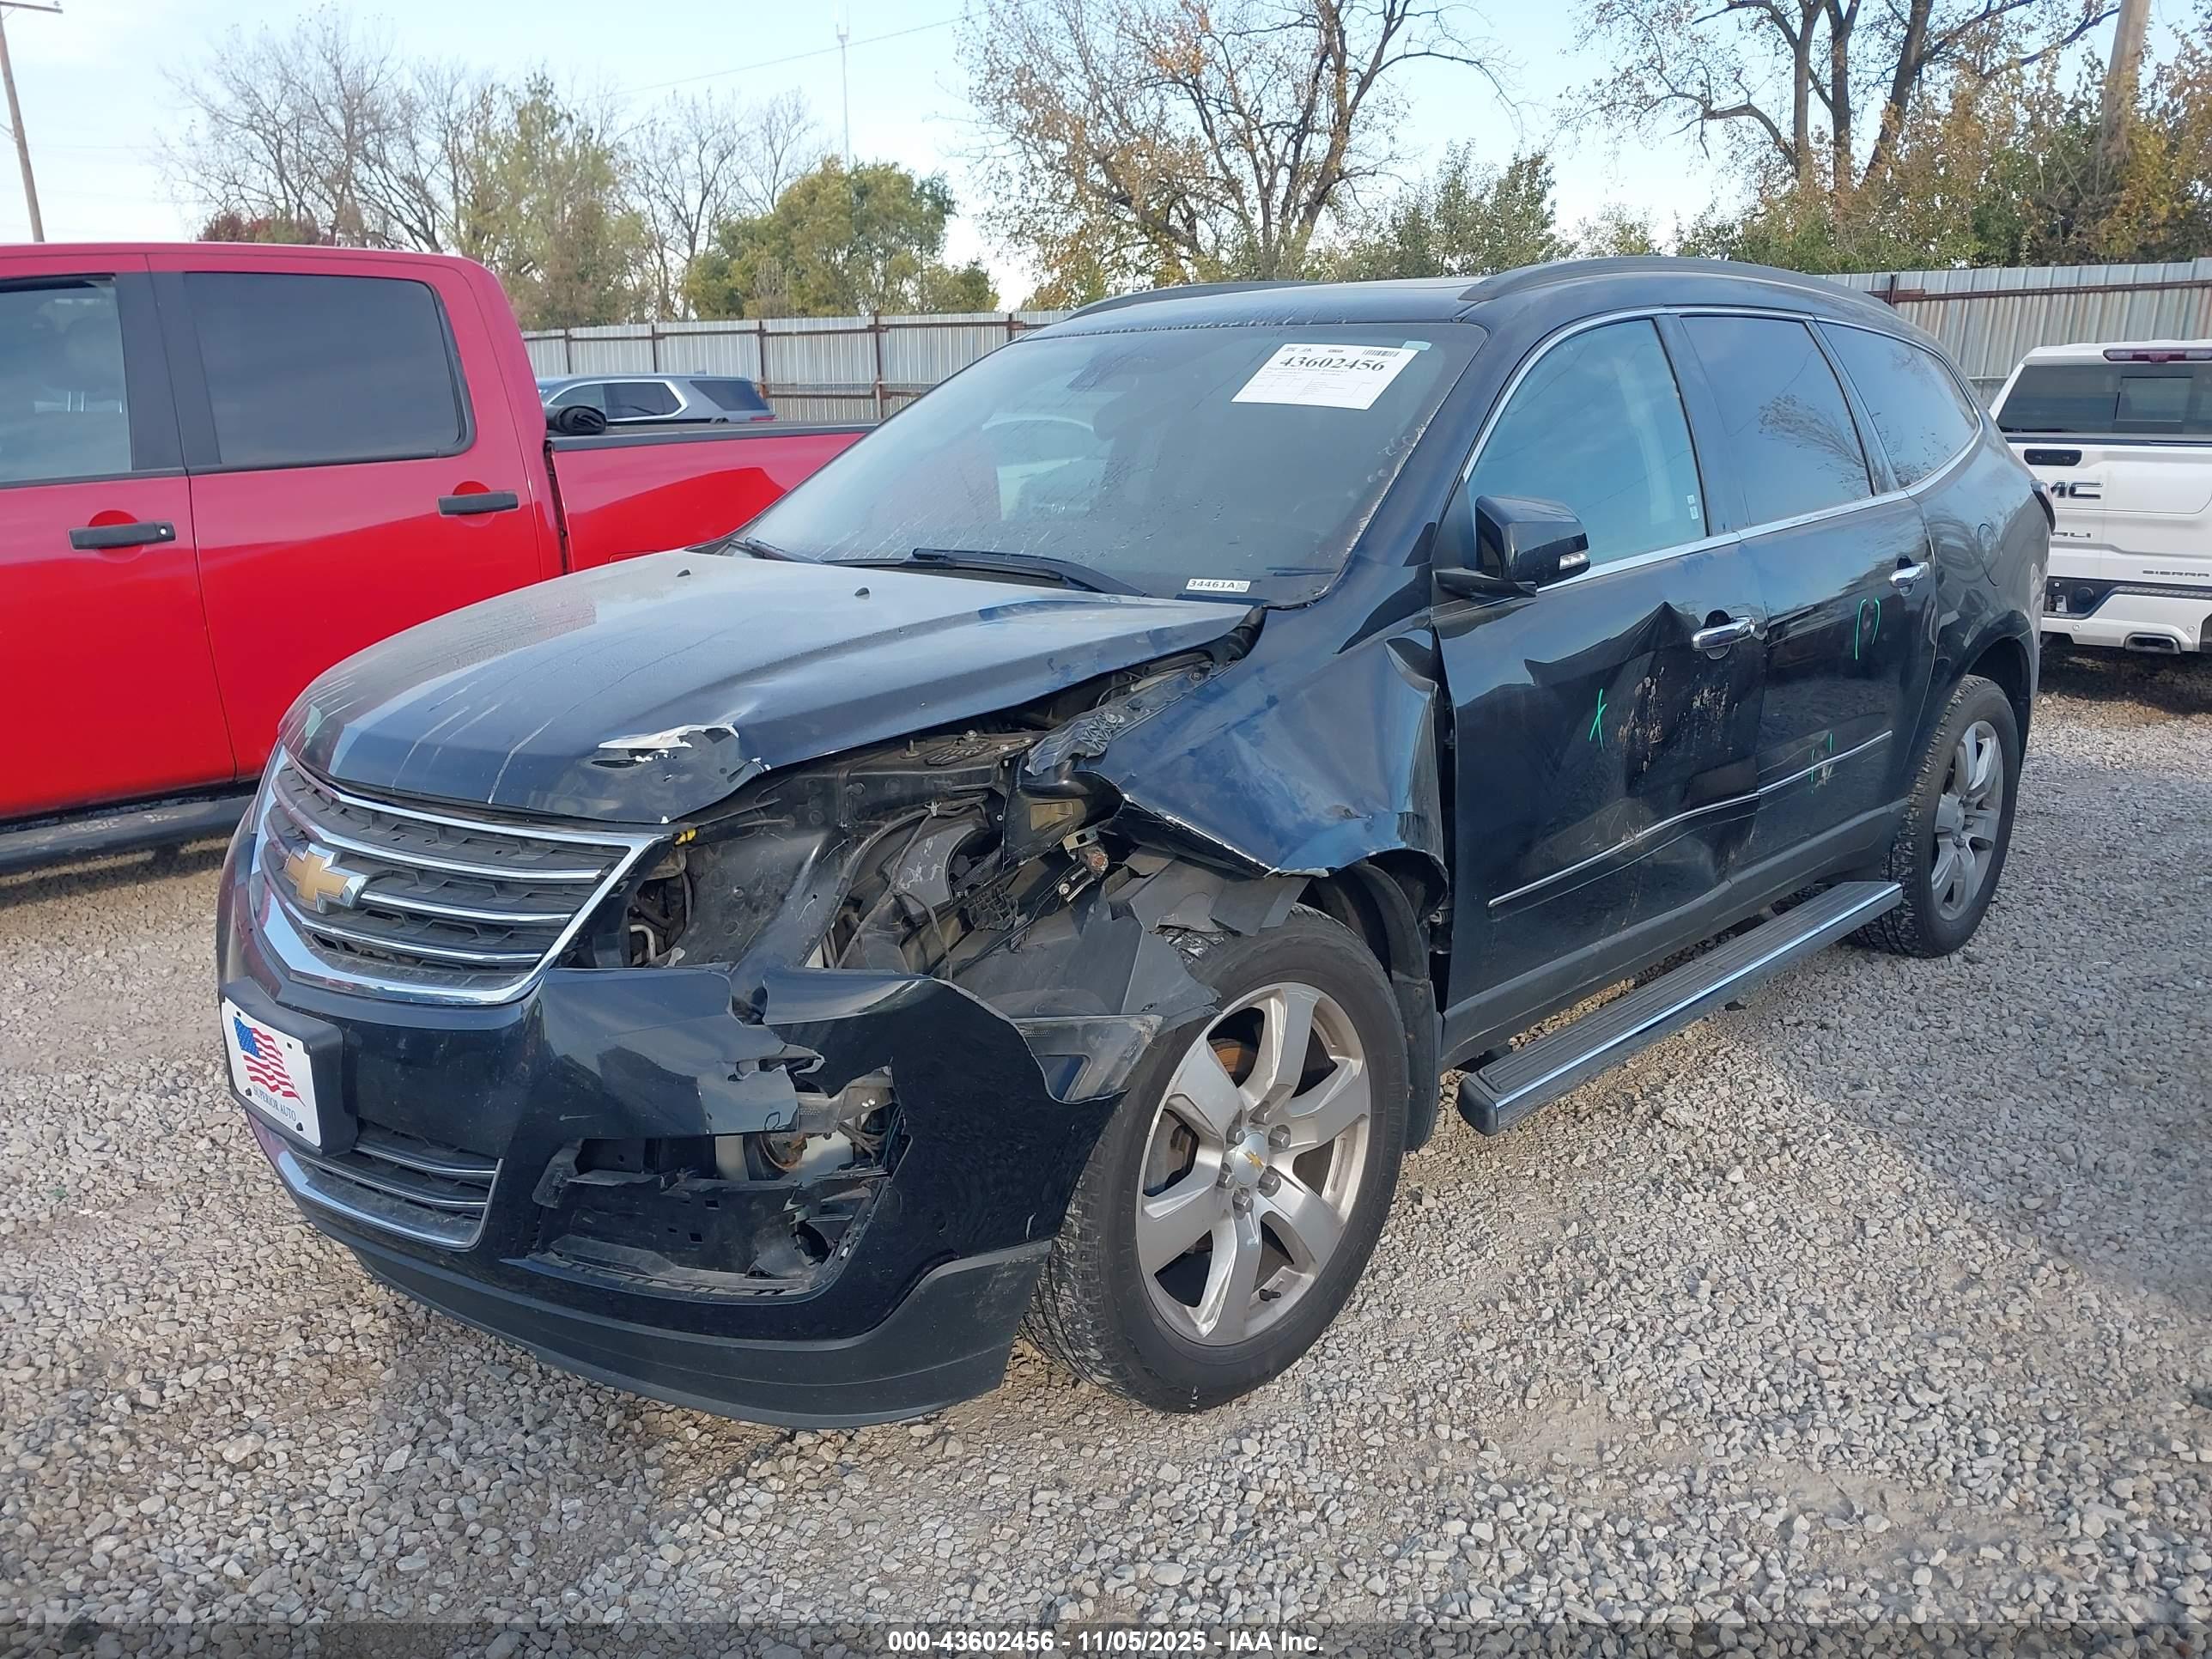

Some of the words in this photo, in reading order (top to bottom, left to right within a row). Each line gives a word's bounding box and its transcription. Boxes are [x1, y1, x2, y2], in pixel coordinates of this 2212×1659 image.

[1279, 356, 1389, 372] 43602456
[2142, 569, 2210, 578] SIERRA
[1188, 580, 1235, 589] 34461A
[253, 1085, 279, 1111] SUPERIOR
[280, 1104, 296, 1121] AUTO
